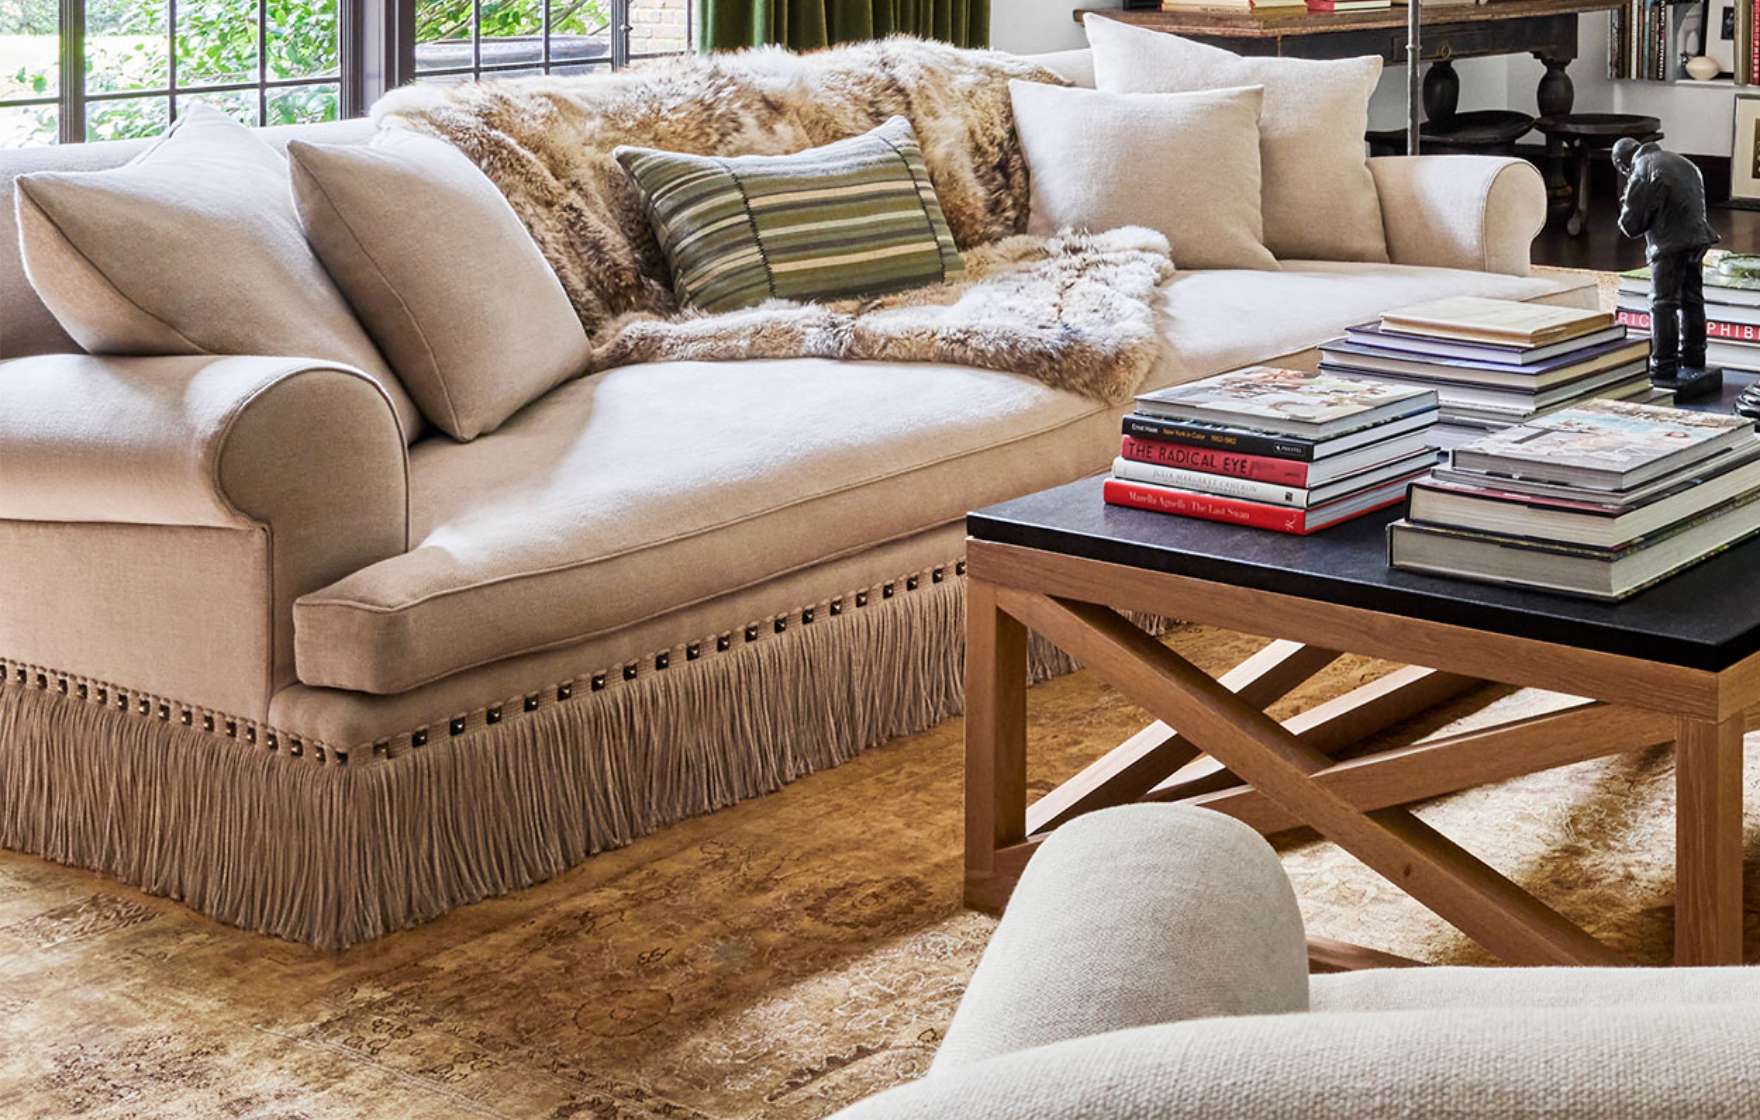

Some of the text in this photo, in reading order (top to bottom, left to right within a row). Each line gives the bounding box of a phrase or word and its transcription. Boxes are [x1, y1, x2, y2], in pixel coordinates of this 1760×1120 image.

[1128, 442, 1153, 460] THE
[1158, 447, 1217, 469] RADICAL
[1223, 457, 1248, 474] EYE
[1192, 501, 1207, 512] The
